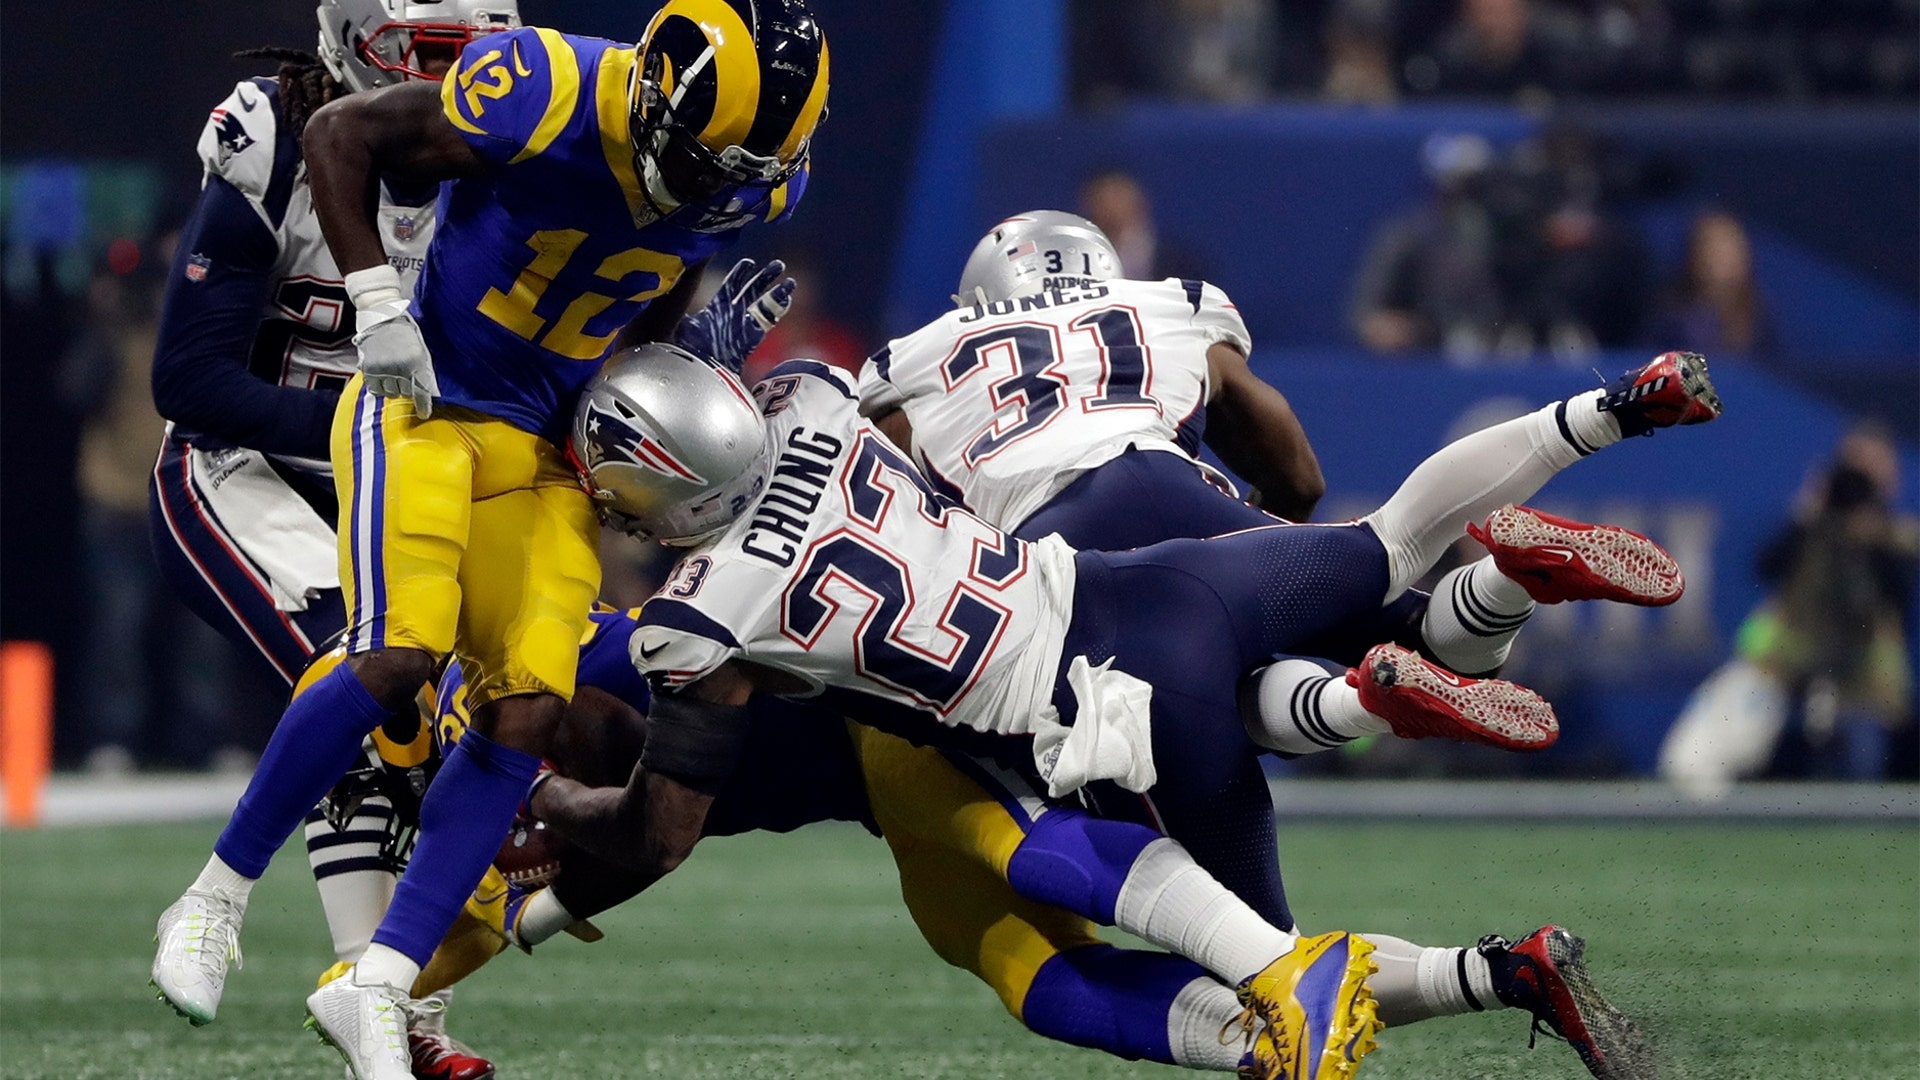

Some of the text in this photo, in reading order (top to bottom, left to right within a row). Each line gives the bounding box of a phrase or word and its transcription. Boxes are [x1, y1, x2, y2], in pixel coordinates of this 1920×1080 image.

[458, 50, 514, 119] 12
[476, 230, 686, 360] 12
[959, 280, 1110, 323] JONES
[939, 304, 1164, 472] 31
[212, 458, 250, 491] Wilson
[741, 426, 843, 568] CHUNG
[779, 427, 1028, 717] 23
